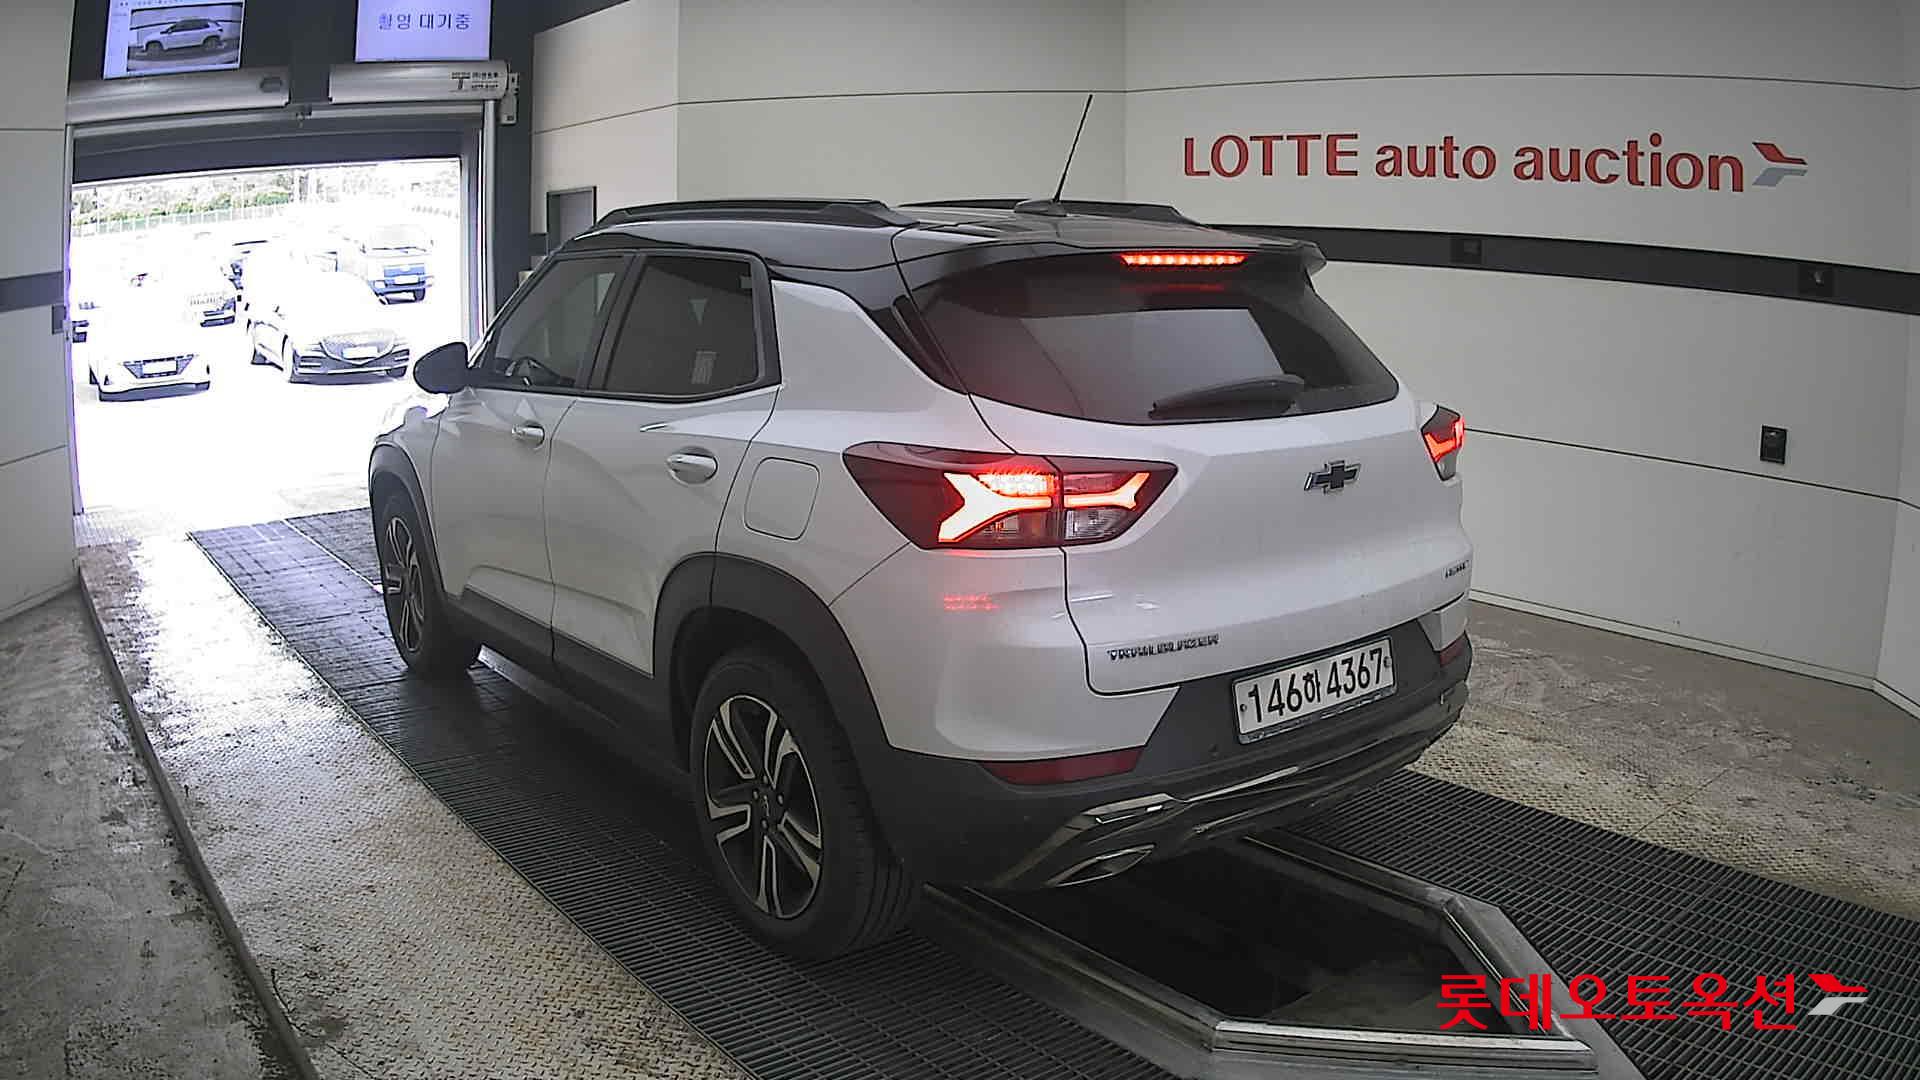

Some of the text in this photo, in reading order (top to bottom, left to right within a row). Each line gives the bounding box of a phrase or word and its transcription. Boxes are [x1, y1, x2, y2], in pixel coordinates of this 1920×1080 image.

[419, 13, 472, 30] 대기중
[1184, 132, 1745, 192] LOTTE auto auction
